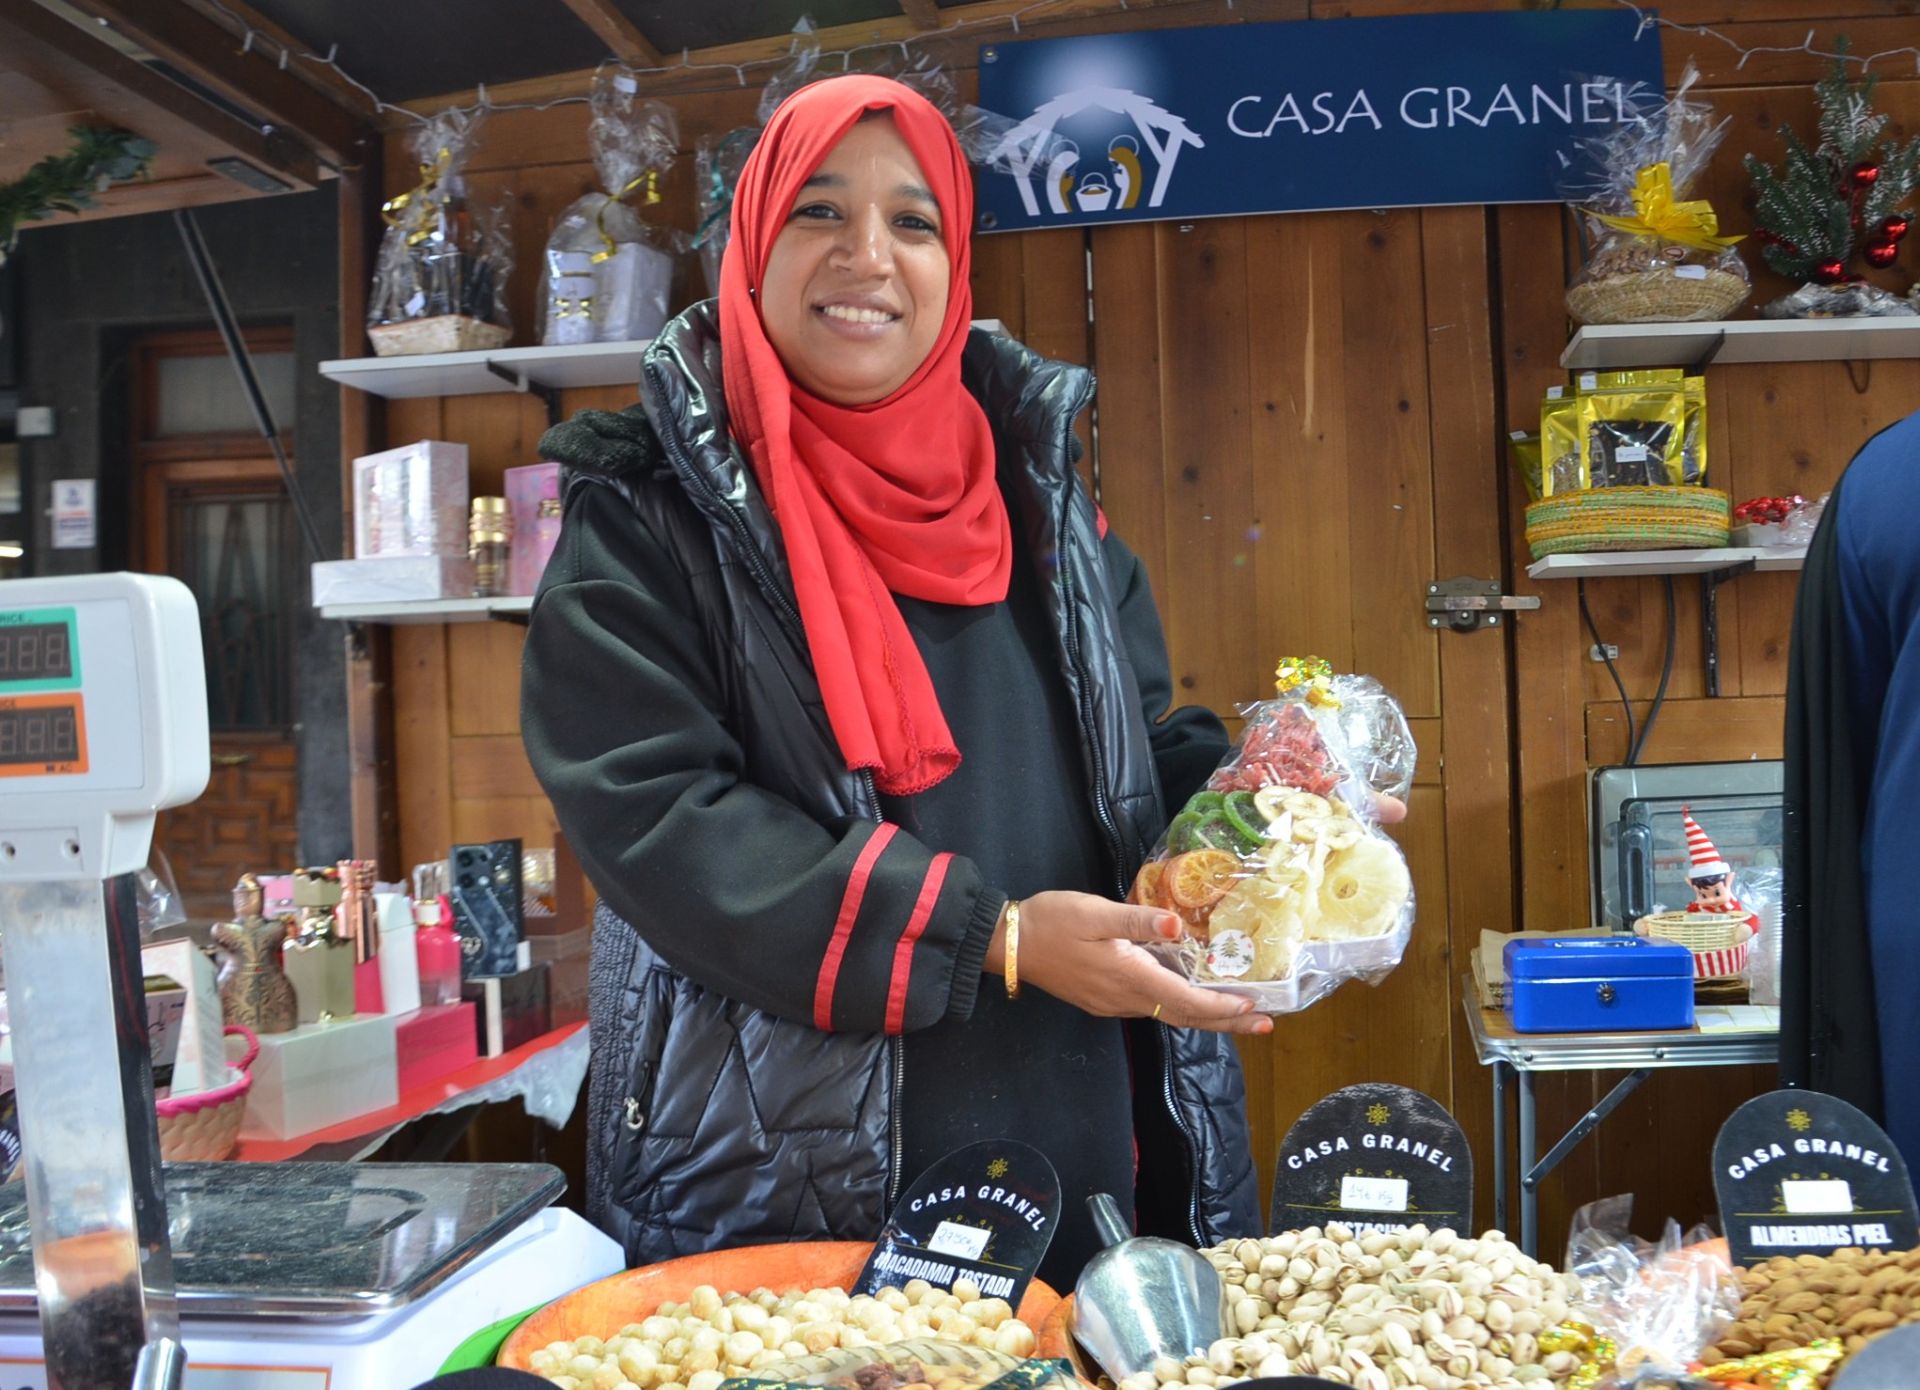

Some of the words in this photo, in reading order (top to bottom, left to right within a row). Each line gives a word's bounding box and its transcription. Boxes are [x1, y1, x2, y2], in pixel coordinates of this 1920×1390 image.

[1226, 88, 1383, 139] CASA
[1399, 81, 1647, 129] GRANEL
[1287, 1136, 1348, 1169] CASA
[1362, 1134, 1453, 1172] GRANEL
[1728, 1143, 1786, 1180] CASA
[1794, 1138, 1890, 1173] GRANEL
[910, 1185, 966, 1212] CASA
[977, 1185, 1047, 1232] GRANEL
[1750, 1224, 1853, 1247] ALMENDRAS
[1852, 1223, 1893, 1245] PIEL
[873, 1252, 956, 1286] MACADAMIA
